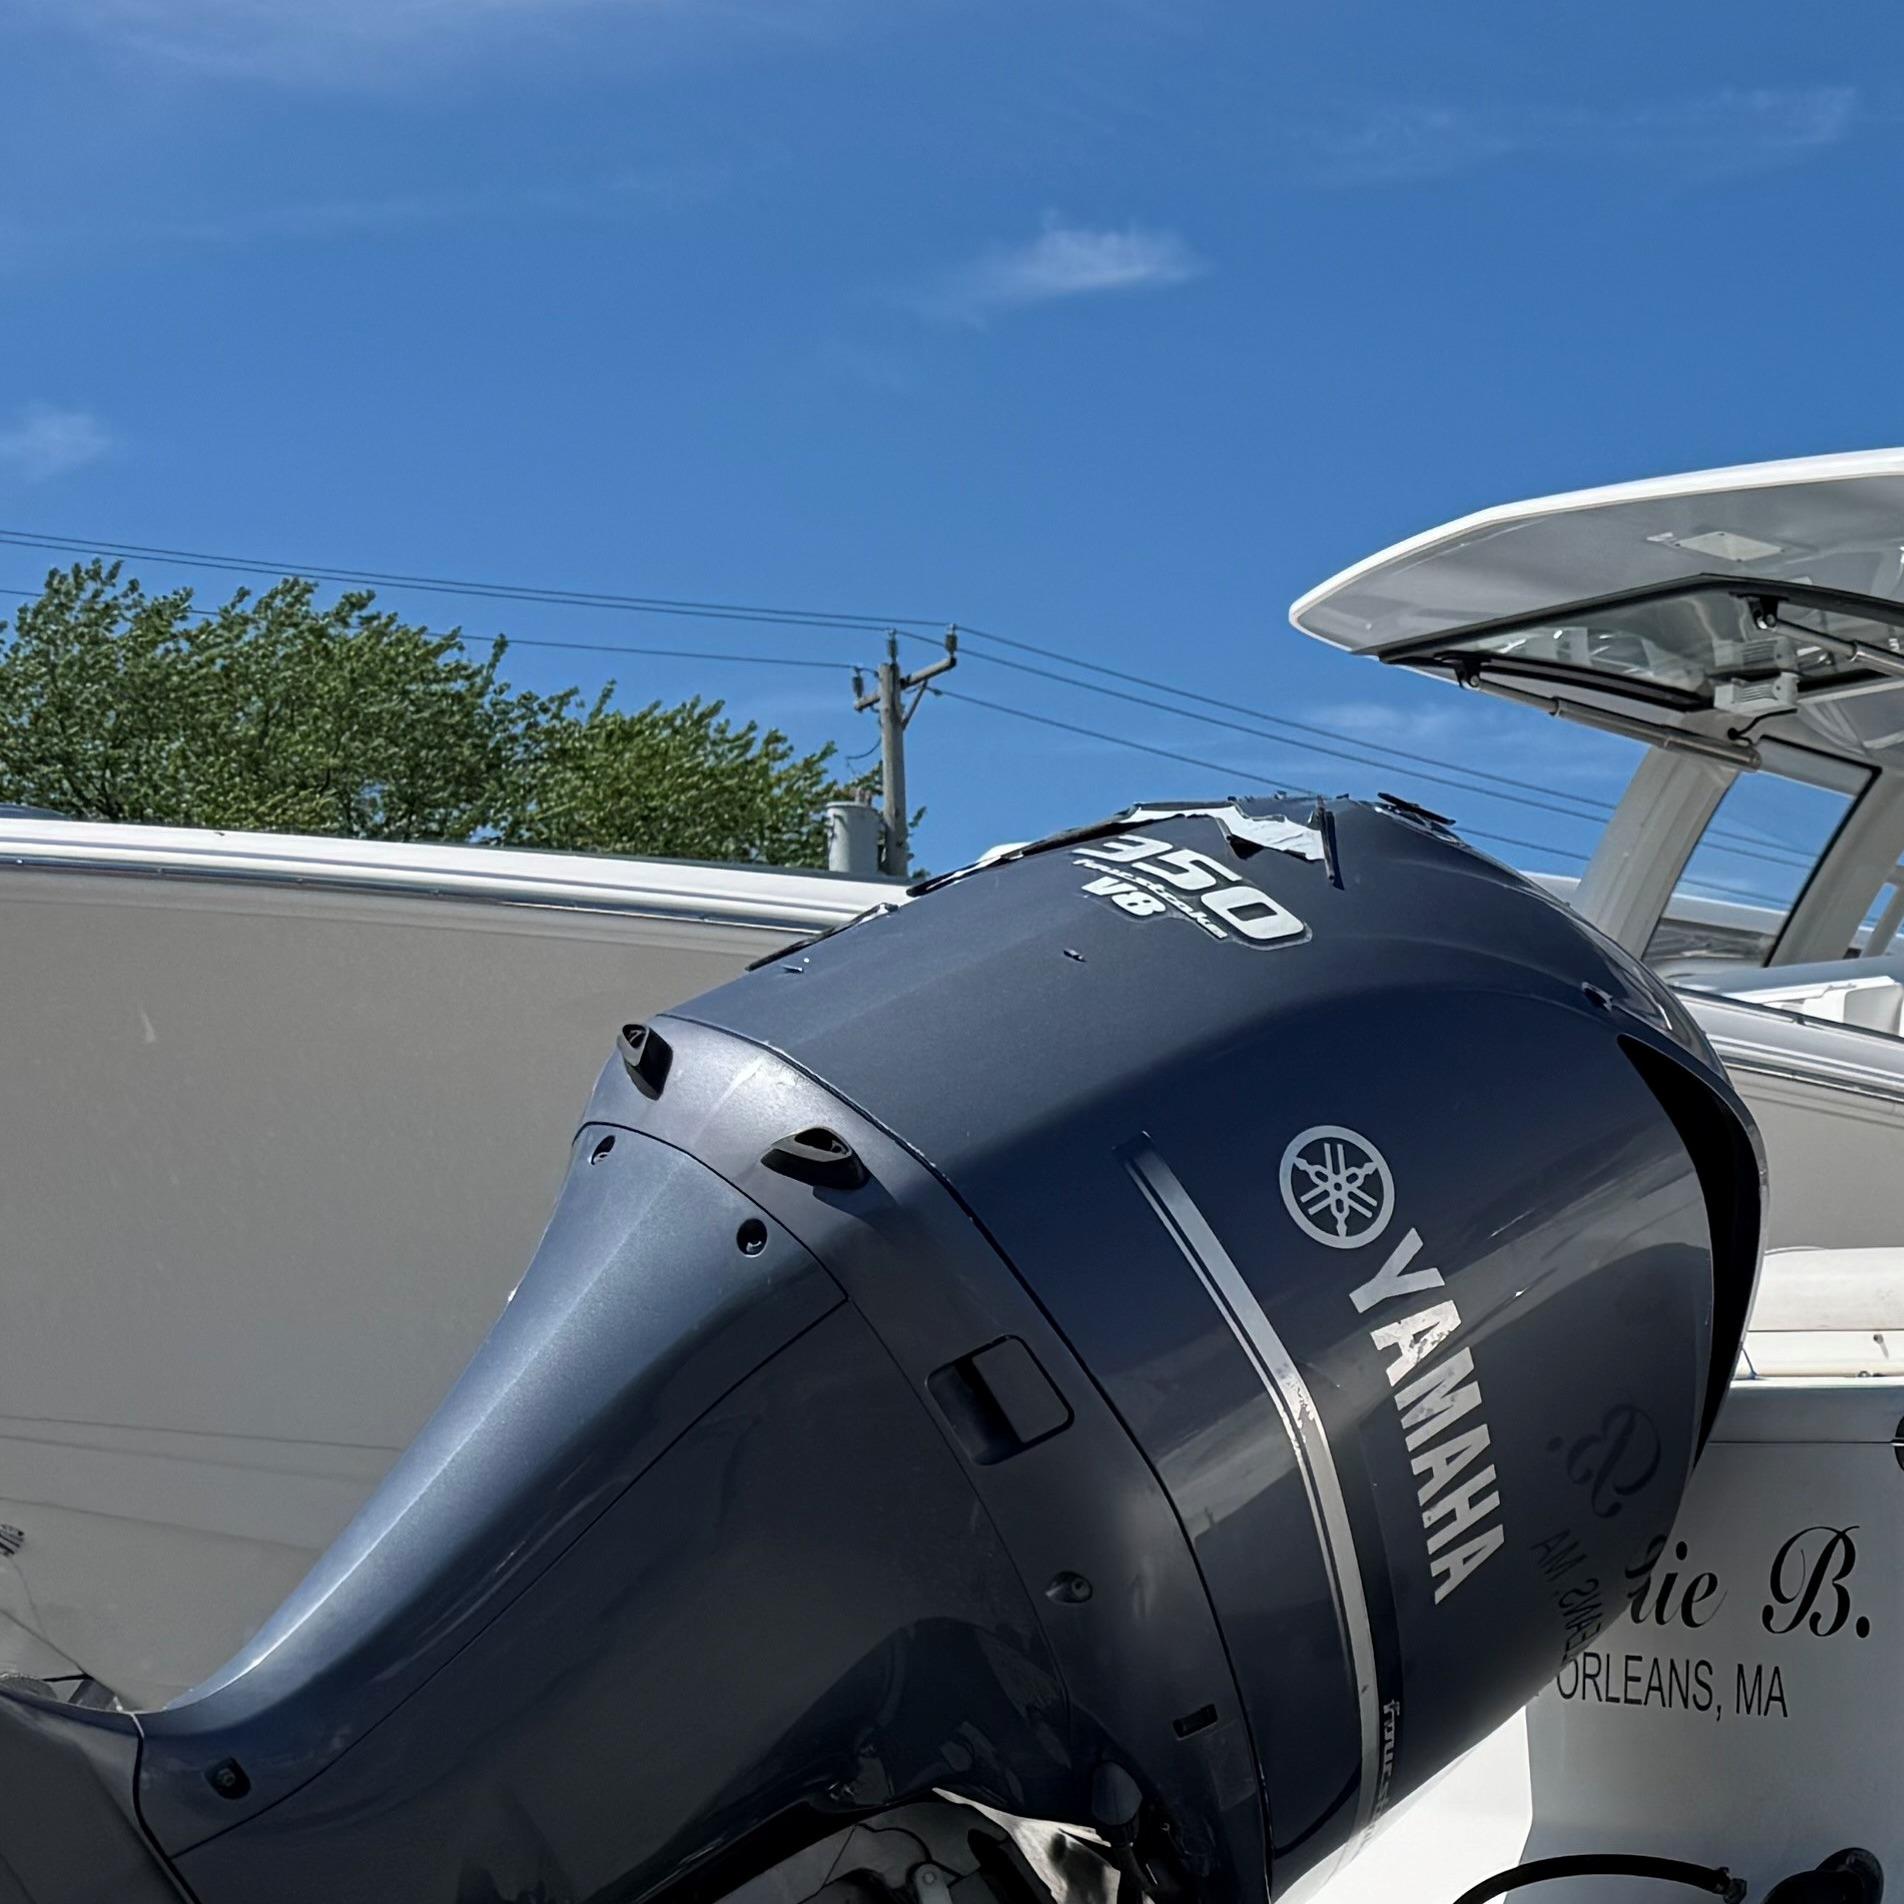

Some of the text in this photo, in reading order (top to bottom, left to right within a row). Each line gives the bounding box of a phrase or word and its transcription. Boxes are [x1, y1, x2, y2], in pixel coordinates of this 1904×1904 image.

[1071, 833, 1305, 940] 350
[1081, 876, 1167, 917] V8
[1349, 1227, 1505, 1606] YAMAHA
[1761, 1525, 1871, 1639] B.
[1735, 1663, 1789, 1719] MA
